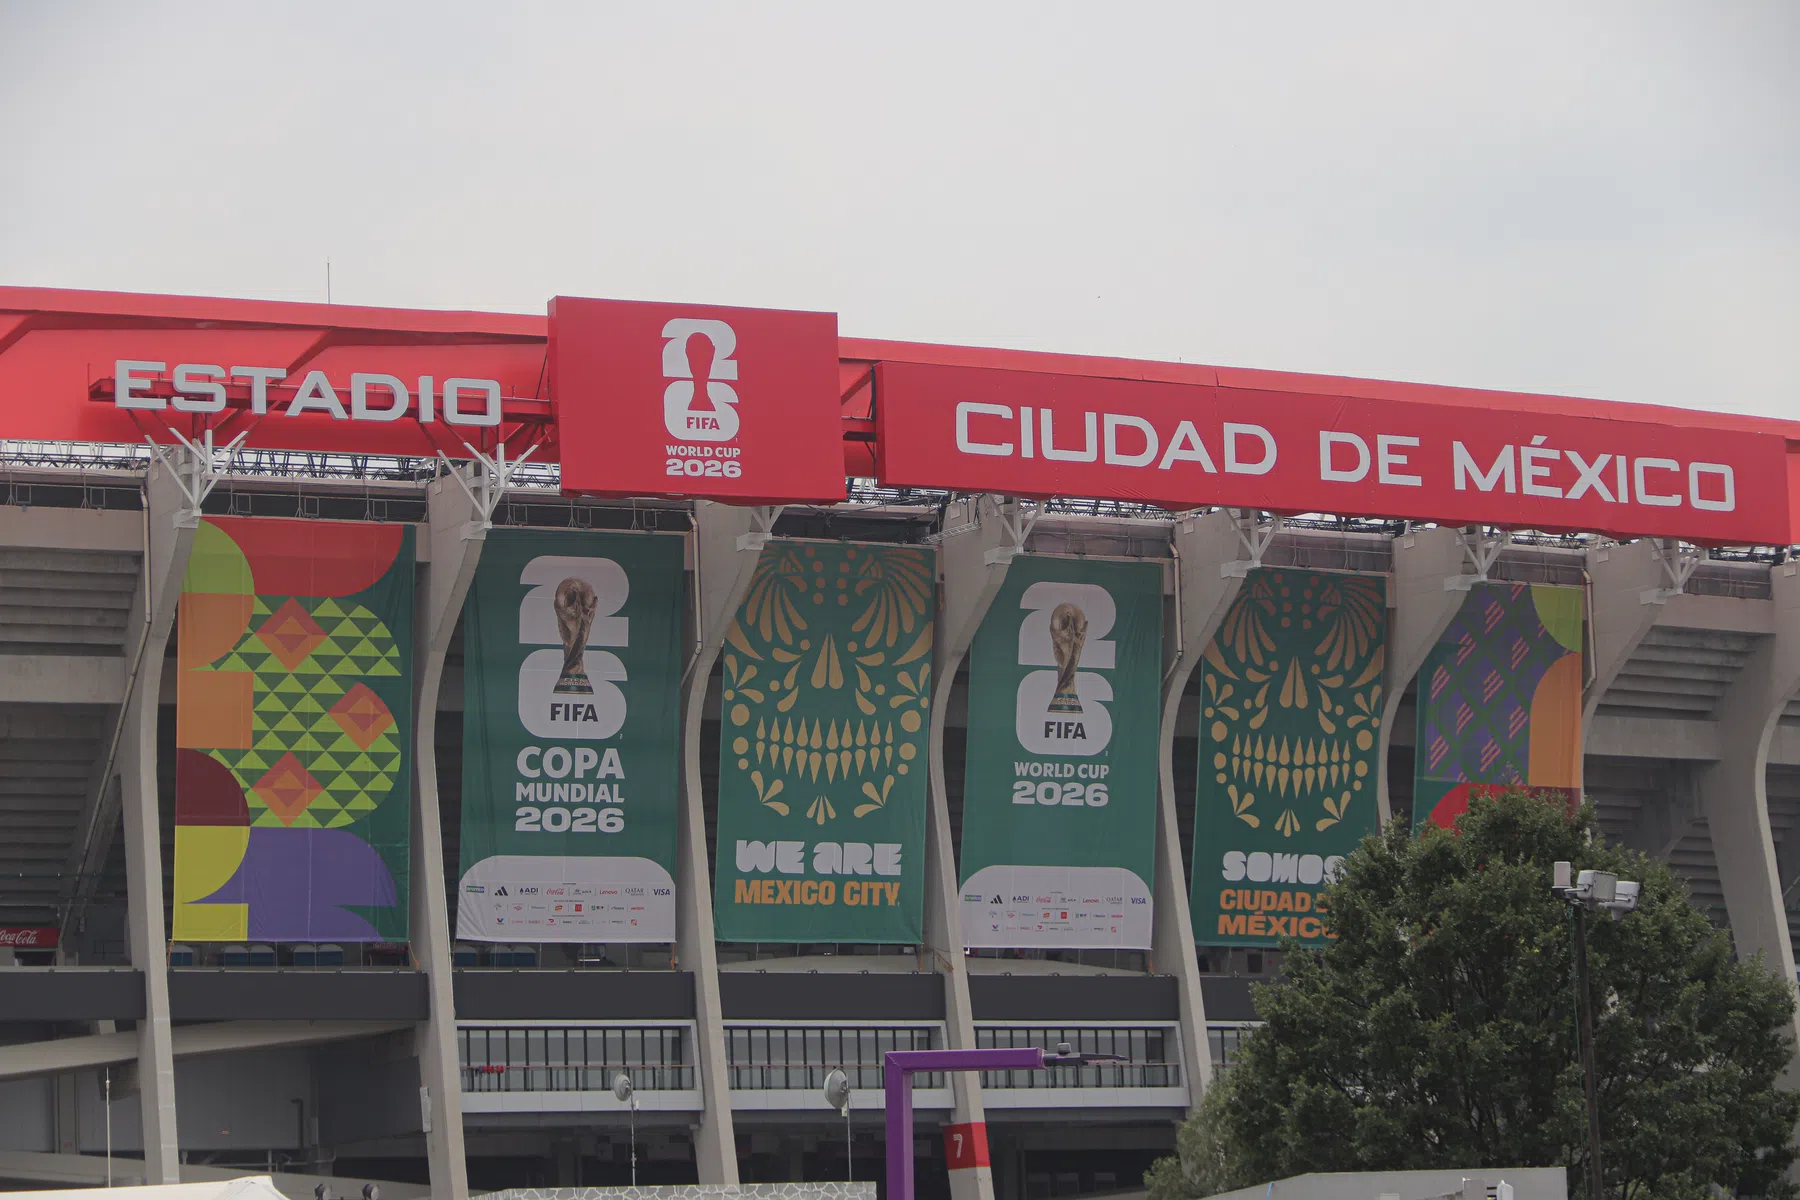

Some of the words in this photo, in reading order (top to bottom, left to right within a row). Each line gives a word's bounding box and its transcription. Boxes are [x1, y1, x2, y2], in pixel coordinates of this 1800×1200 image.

[115, 359, 501, 427] ESTADIO
[686, 417, 720, 430] FIFA
[666, 445, 713, 457] WORLD
[715, 447, 741, 458] CUP
[956, 401, 1278, 475] CIUDAD
[1319, 430, 1422, 487] DE
[1452, 434, 1736, 512] MÉXICO
[666, 458, 742, 478] 2026
[550, 703, 599, 722] FIFA
[1044, 721, 1087, 739] FIFA
[516, 746, 625, 779] COPA
[1014, 761, 1075, 777] WORLD
[1077, 763, 1110, 779] CUP
[515, 782, 625, 803] MUNDIAL
[1012, 780, 1109, 807] 2026
[515, 806, 625, 833] 2026
[735, 839, 805, 874] WE
[812, 841, 902, 876] ARE
[1221, 850, 1347, 885] SOMOS
[653, 888, 671, 896] VISA
[734, 879, 836, 905] MEXICO
[843, 881, 900, 906] CITY
[1131, 897, 1147, 905] VISA
[1219, 888, 1311, 913] CIUDAD
[953, 1133, 963, 1158] 7
